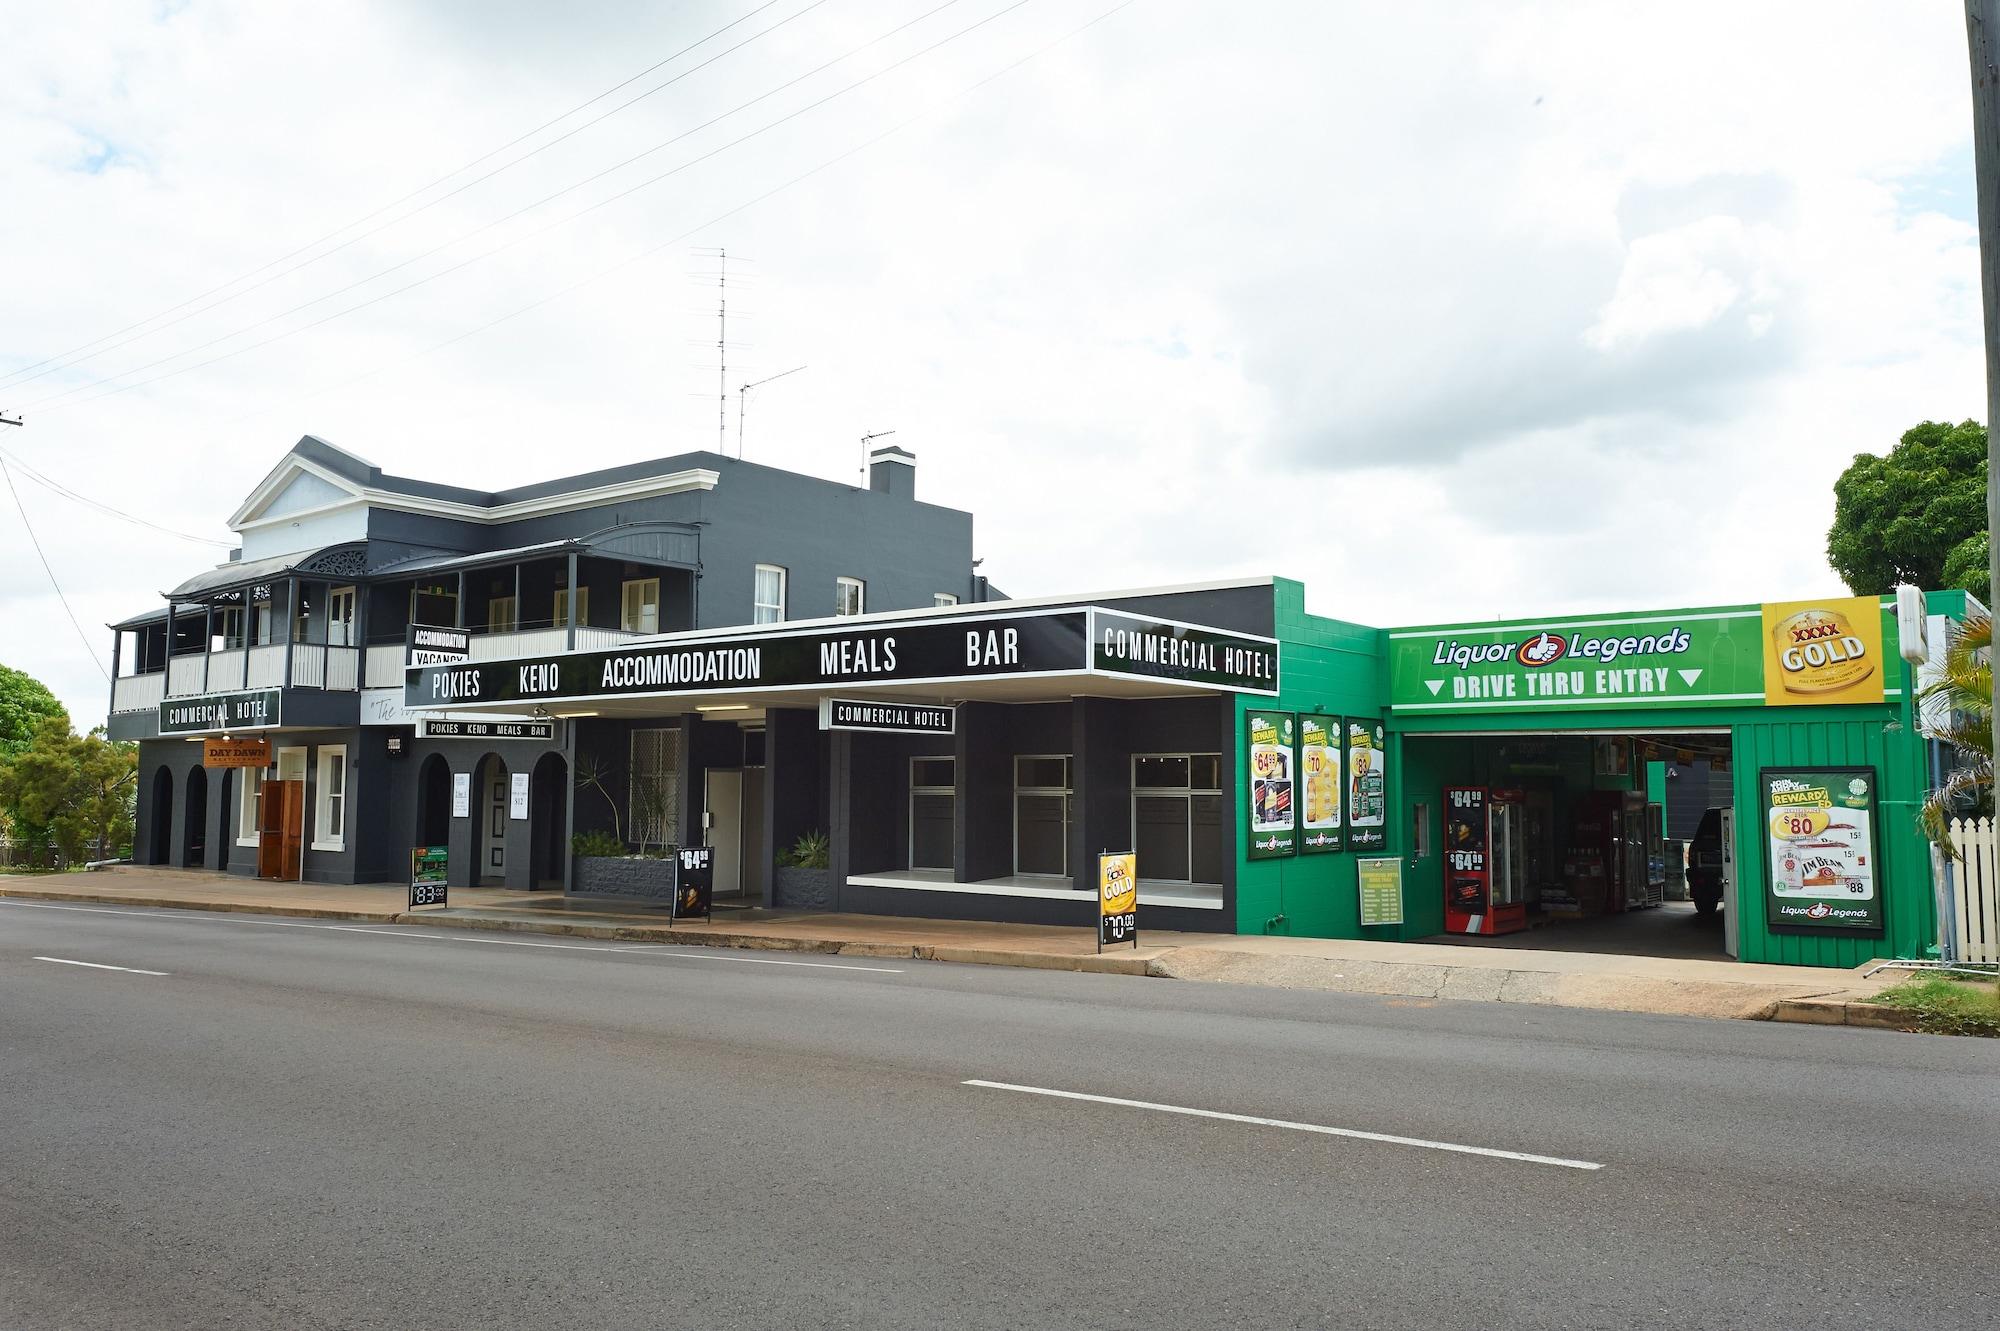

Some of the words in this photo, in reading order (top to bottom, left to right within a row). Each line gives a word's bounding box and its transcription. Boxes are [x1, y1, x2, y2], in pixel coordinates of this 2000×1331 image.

[415, 630, 467, 649] ACCOMMODATION
[1792, 623, 1840, 643] XXXX
[1104, 627, 1217, 672] COMMERCIAL
[1225, 646, 1272, 679] HOTEL
[1433, 640, 1517, 669] Liquor
[1567, 627, 1691, 663] Legends
[1782, 636, 1866, 673] GOLD
[432, 669, 480, 698] POKIES
[519, 663, 559, 693] KENO
[601, 647, 761, 688] ACCOMMODATION
[820, 637, 897, 675] MEALS
[966, 627, 1018, 667] BAR
[1453, 674, 1516, 699] DRIVE
[1525, 671, 1584, 696] THRU
[1595, 667, 1669, 694] ENTRY
[169, 704, 230, 725] COMMERCIAL
[237, 700, 268, 719] HOTEL
[838, 705, 909, 725] COMMERCIAL
[914, 711, 947, 727] HOTEL
[430, 722, 459, 734] POKIES
[467, 724, 487, 735] KENO
[497, 724, 522, 735] MEALS
[531, 726, 546, 736] BAR
[209, 749, 231, 757] DAY
[233, 749, 265, 757] DAWN
[1784, 815, 1812, 834] $80
[1104, 876, 1133, 900] GOLD
[1780, 905, 1809, 916] Liquor
[1829, 908, 1868, 918] Legends
